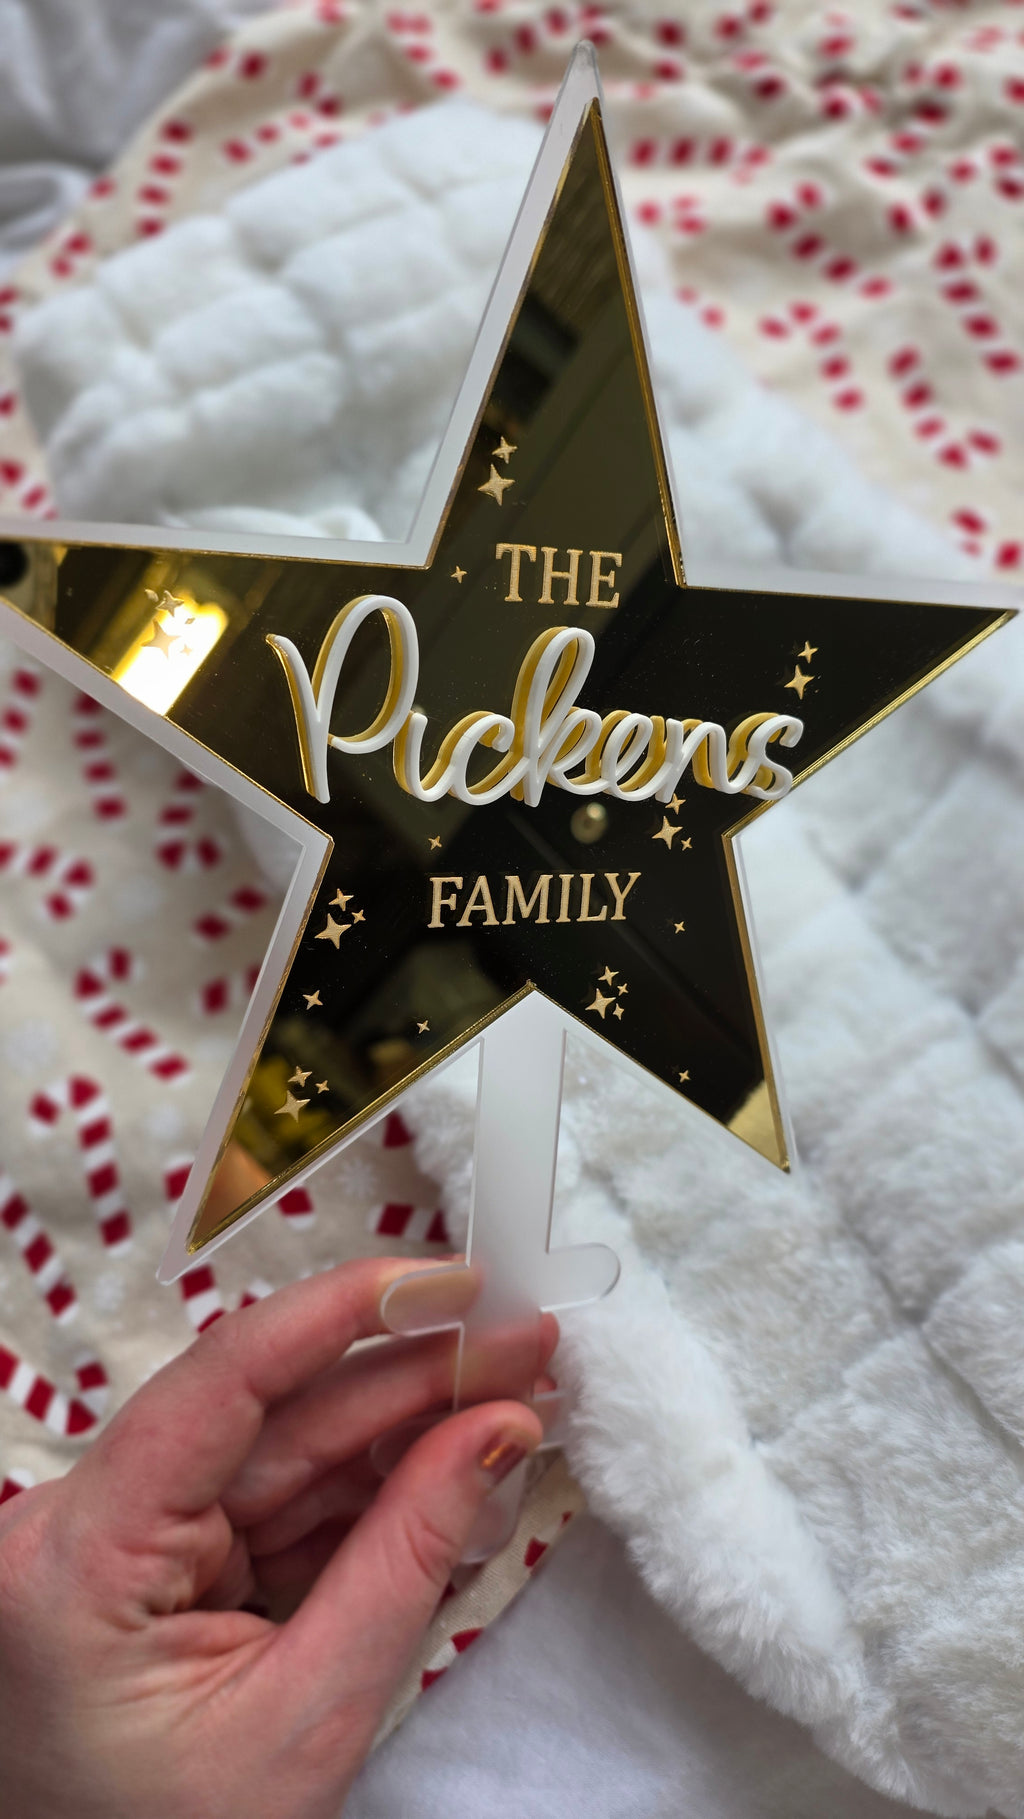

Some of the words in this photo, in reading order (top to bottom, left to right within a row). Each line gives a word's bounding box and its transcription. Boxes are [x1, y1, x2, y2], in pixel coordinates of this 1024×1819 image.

[495, 543, 623, 609] THE
[267, 594, 804, 807] Pickens
[427, 872, 642, 929] FAMILY
